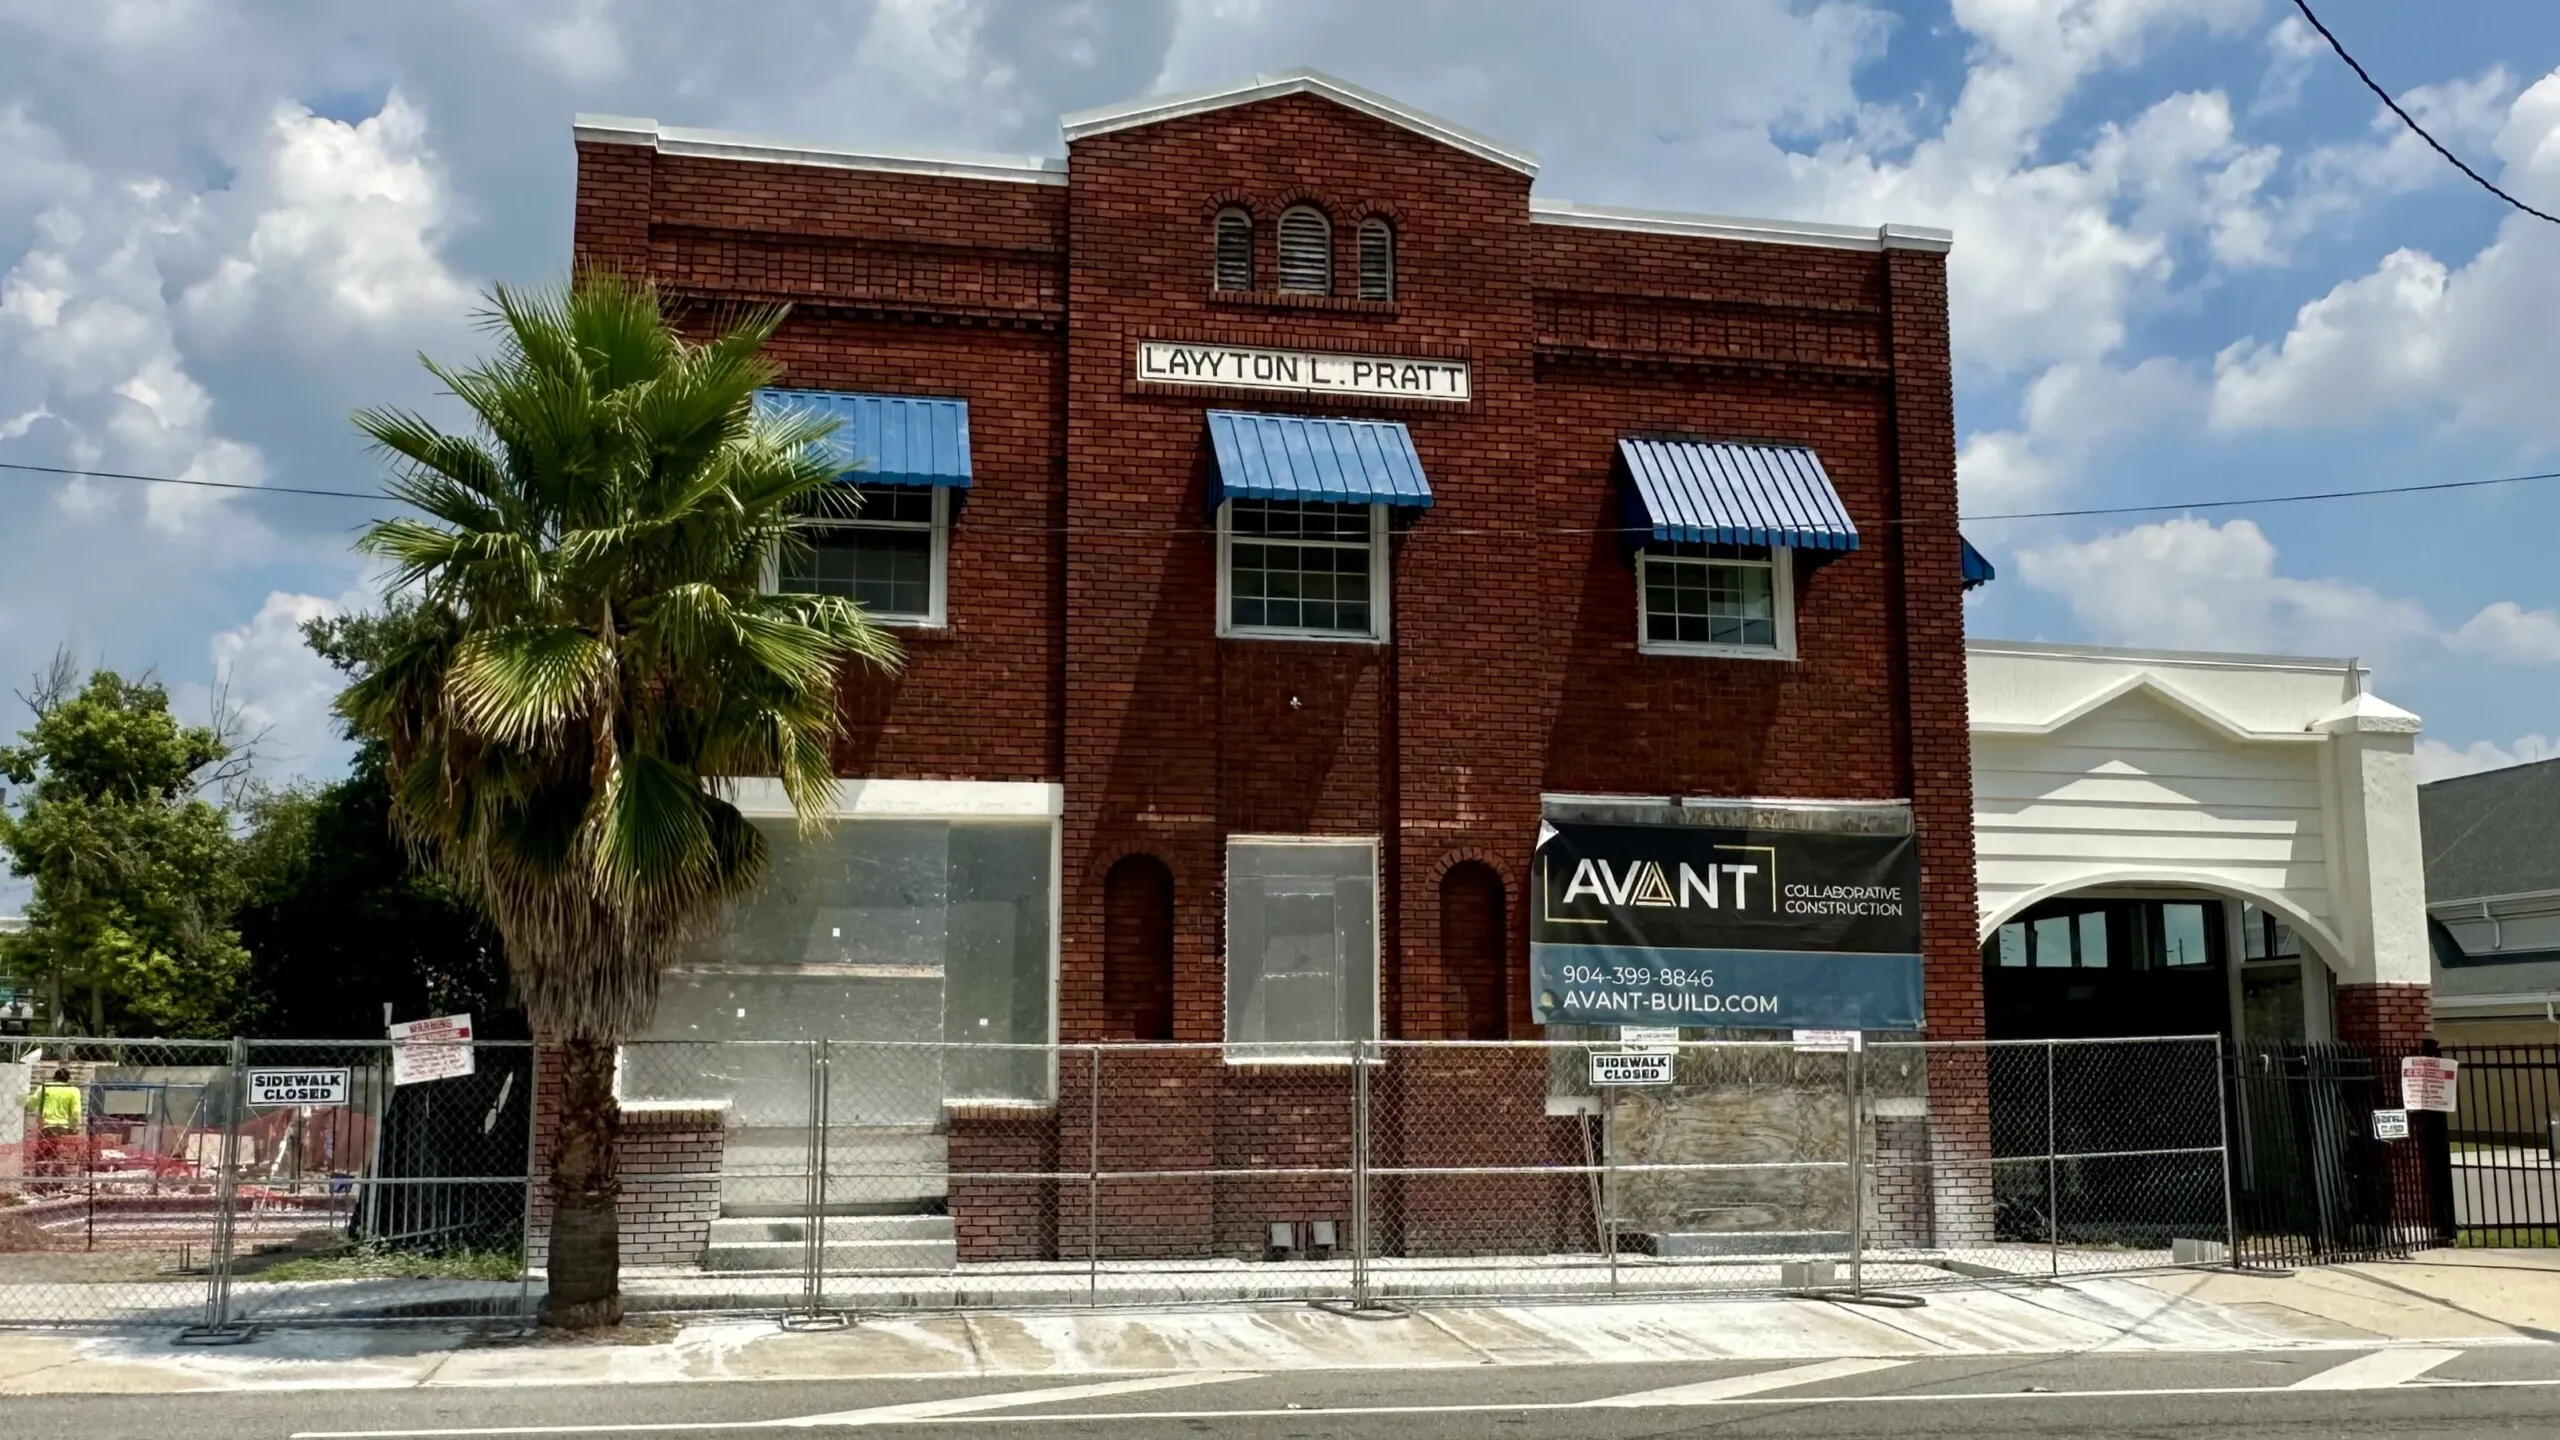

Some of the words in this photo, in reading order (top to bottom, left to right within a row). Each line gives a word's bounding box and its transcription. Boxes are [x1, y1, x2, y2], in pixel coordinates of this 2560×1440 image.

[1145, 347, 1298, 382] LAYYTON
[1311, 358, 1346, 386] L.
[1353, 361, 1464, 392] PRATT
[1562, 858, 1758, 909] AVANT
[1784, 884, 1901, 900] COLLABORATIVE
[1785, 900, 1903, 916] CONSTRUCTION
[1563, 965, 1714, 987] 904-399-8846
[1563, 990, 1778, 1013] AVANT-BUILD.COM
[1596, 1057, 1666, 1068] SIDEWALK
[254, 1075, 341, 1087] SIDEWALK
[1604, 1069, 1659, 1079] CLOSED
[263, 1088, 331, 1100] CLOSED
